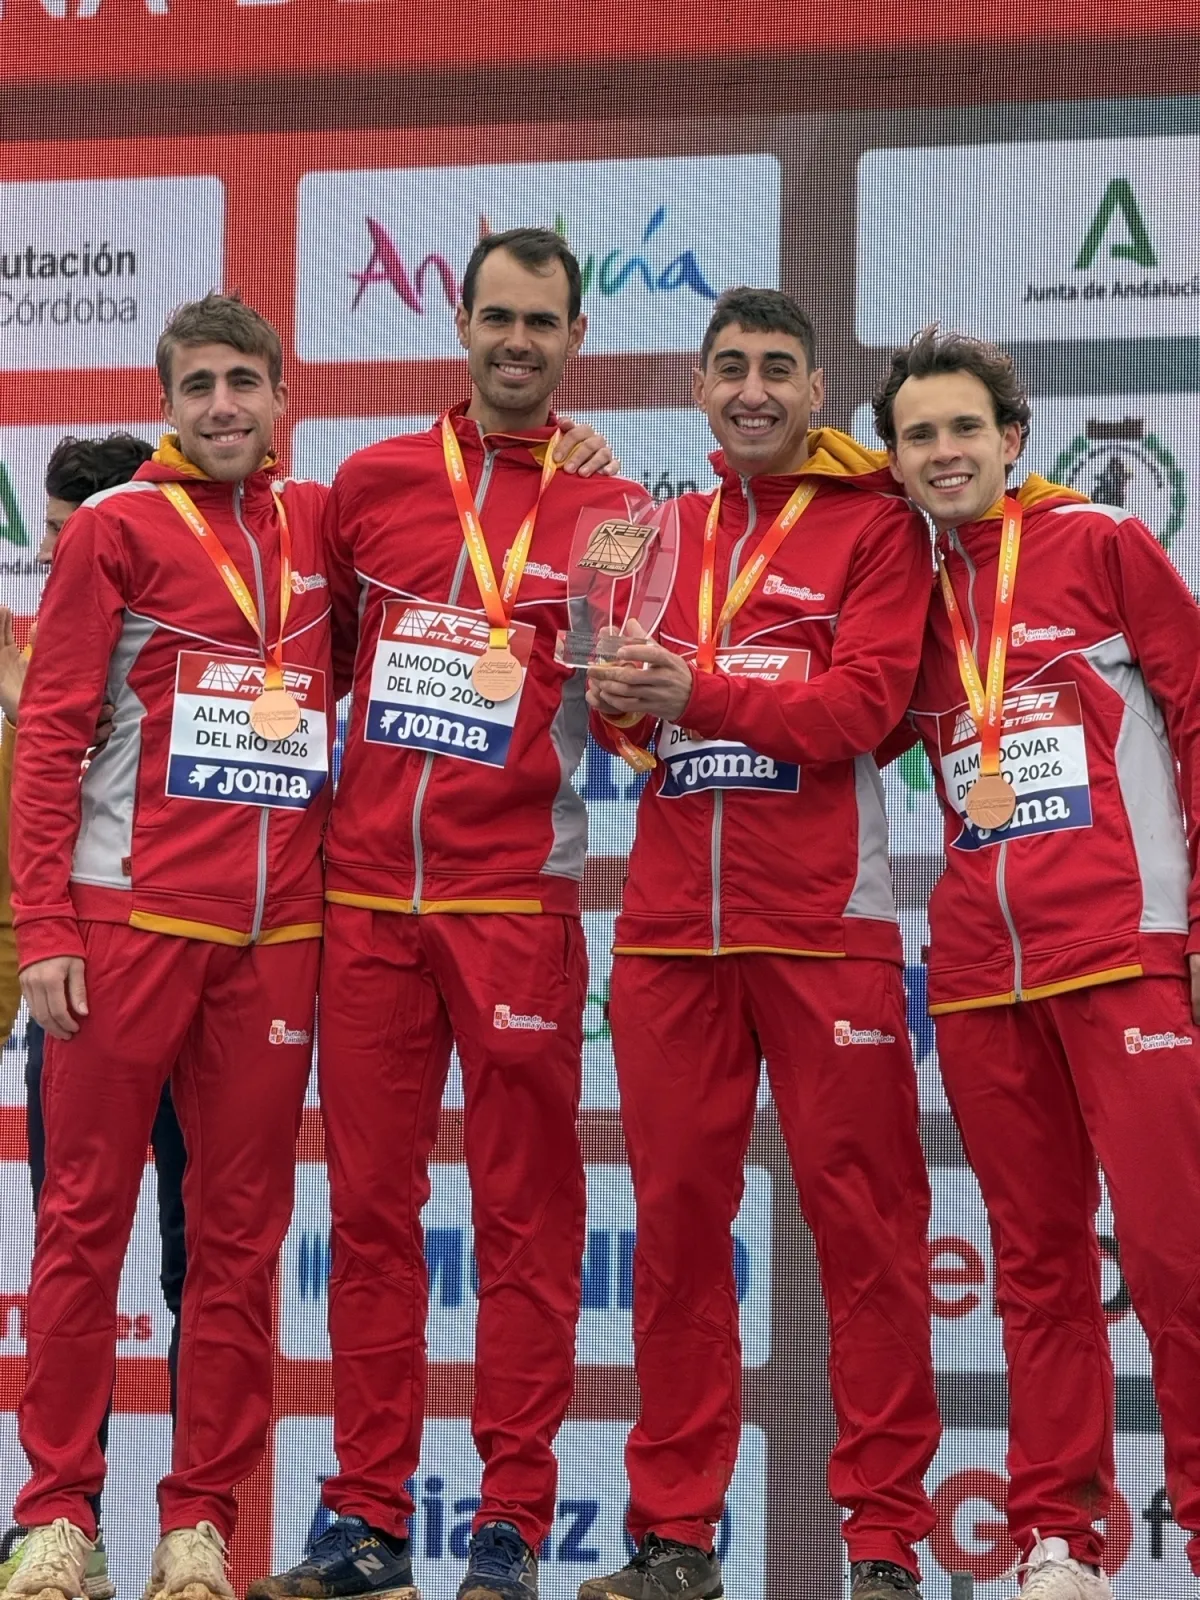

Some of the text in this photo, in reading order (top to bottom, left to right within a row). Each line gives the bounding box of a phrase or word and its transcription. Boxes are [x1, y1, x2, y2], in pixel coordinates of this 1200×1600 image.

[1024, 276, 1200, 303] Junta de Andalucí
[600, 524, 652, 538] RFEA
[242, 666, 313, 691] REA
[387, 652, 474, 680] ALMODÓV
[387, 676, 413, 694] DEL
[417, 677, 446, 698] RÍO
[1002, 691, 1060, 719] FEA
[196, 730, 308, 758] DEL RÍO 2026
[1019, 761, 1063, 783] 2026
